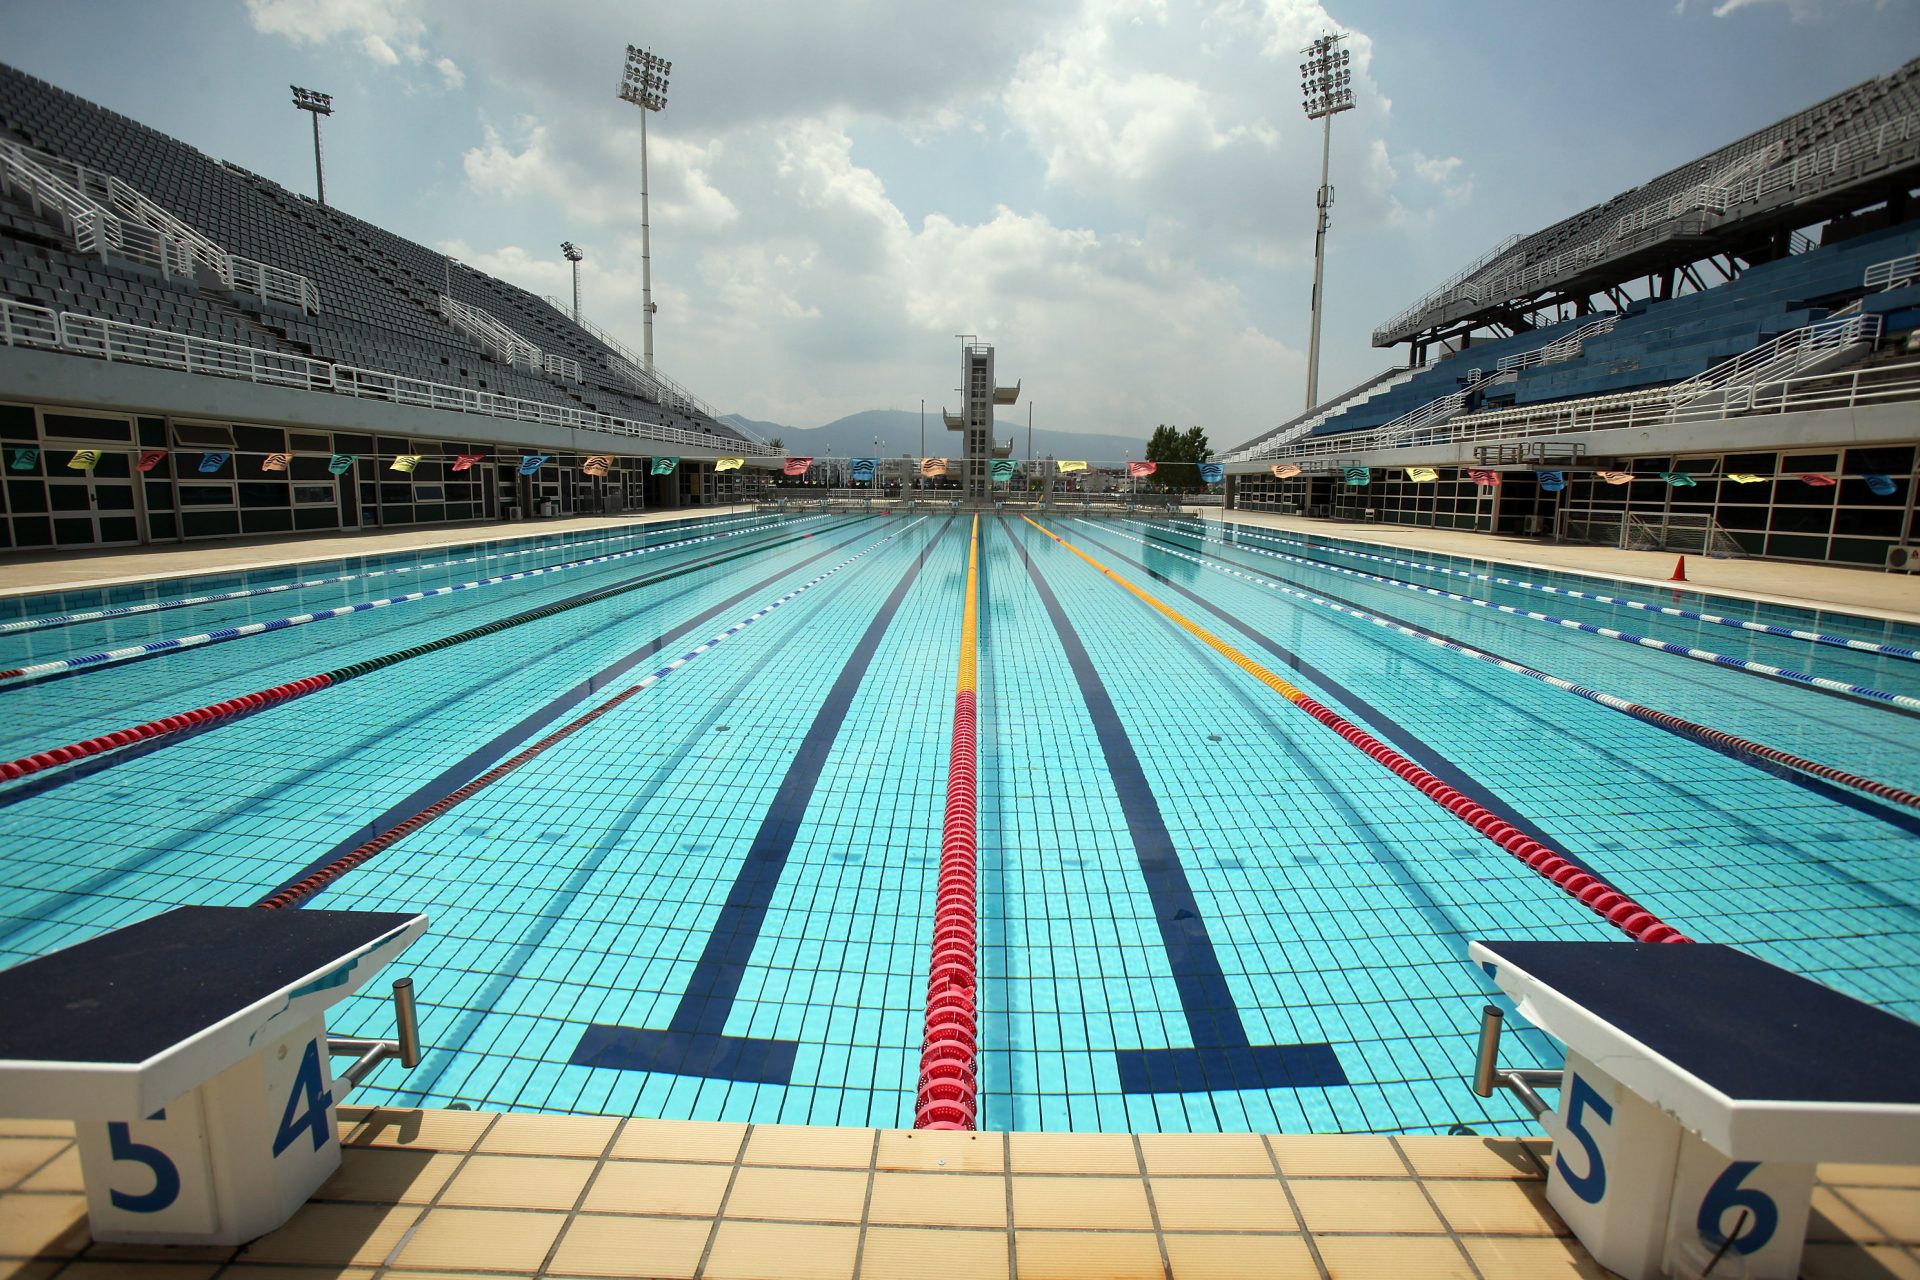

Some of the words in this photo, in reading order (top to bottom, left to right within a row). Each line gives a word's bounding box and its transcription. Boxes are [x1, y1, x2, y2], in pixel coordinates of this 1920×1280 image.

[272, 1037, 333, 1160] 4
[1556, 1072, 1613, 1205] 5
[107, 1107, 181, 1214] 5
[1697, 1161, 1778, 1256] 6
